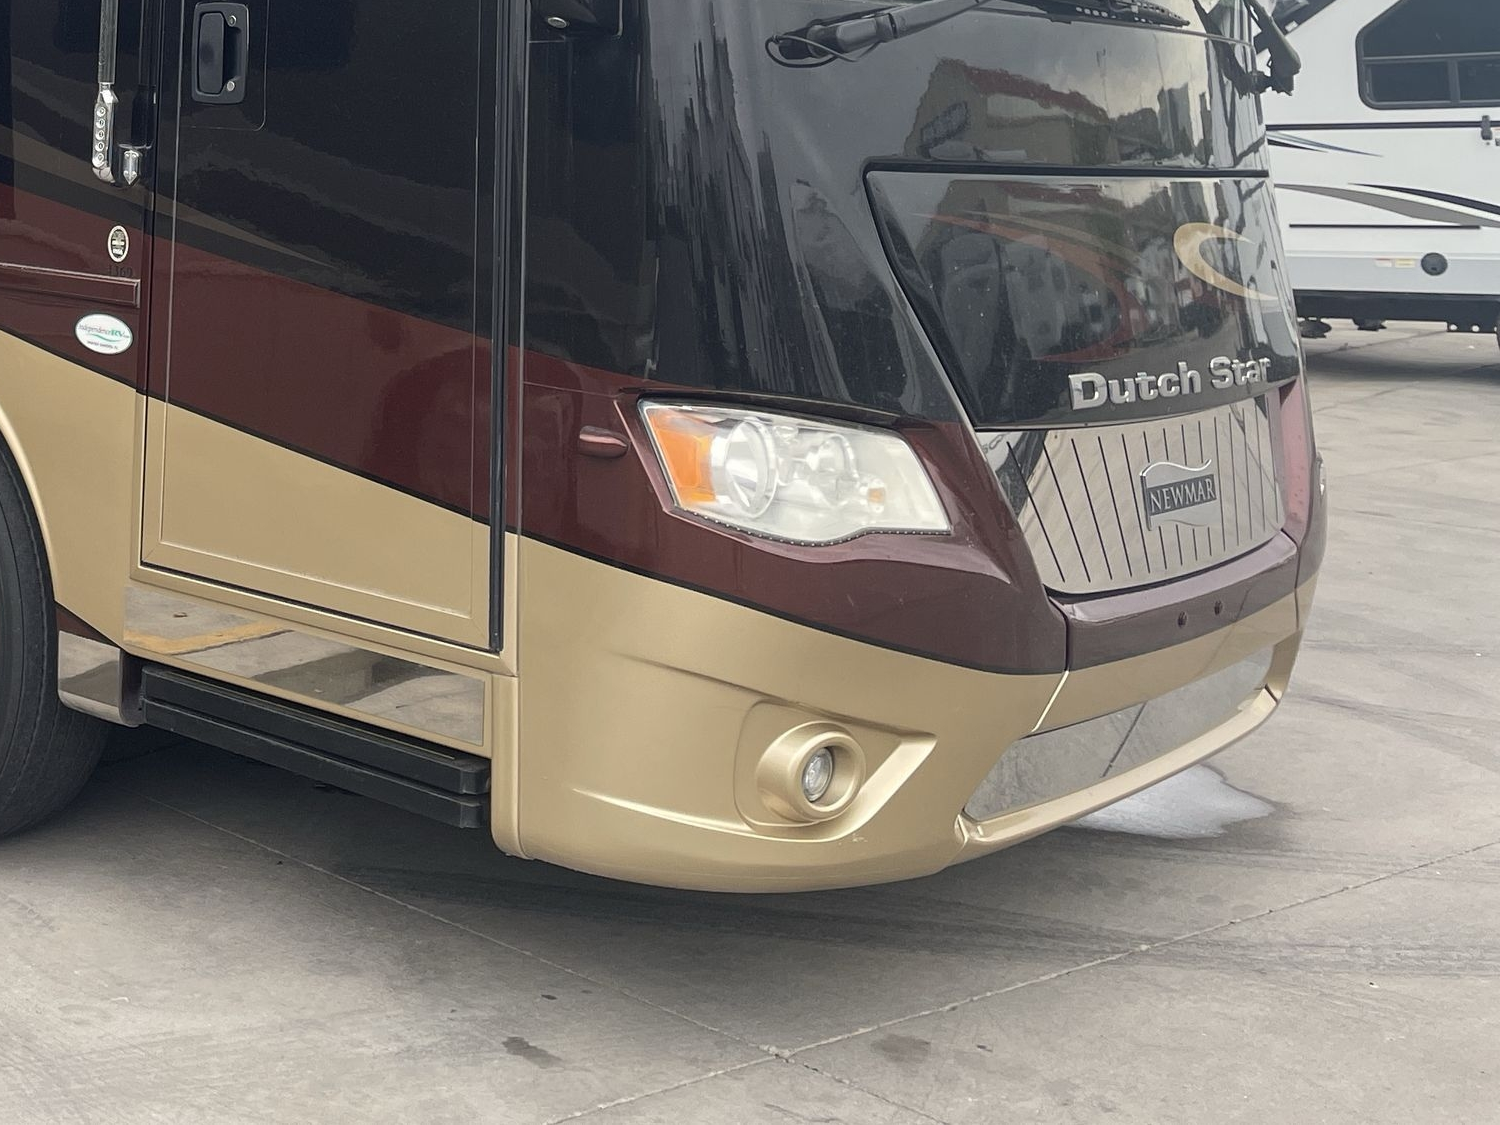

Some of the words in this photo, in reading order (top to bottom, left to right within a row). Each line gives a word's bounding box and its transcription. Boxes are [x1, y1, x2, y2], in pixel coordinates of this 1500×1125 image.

[1067, 361, 1203, 411] Dutch
[1209, 355, 1272, 390] Star
[1149, 478, 1216, 513] NEWMAR
